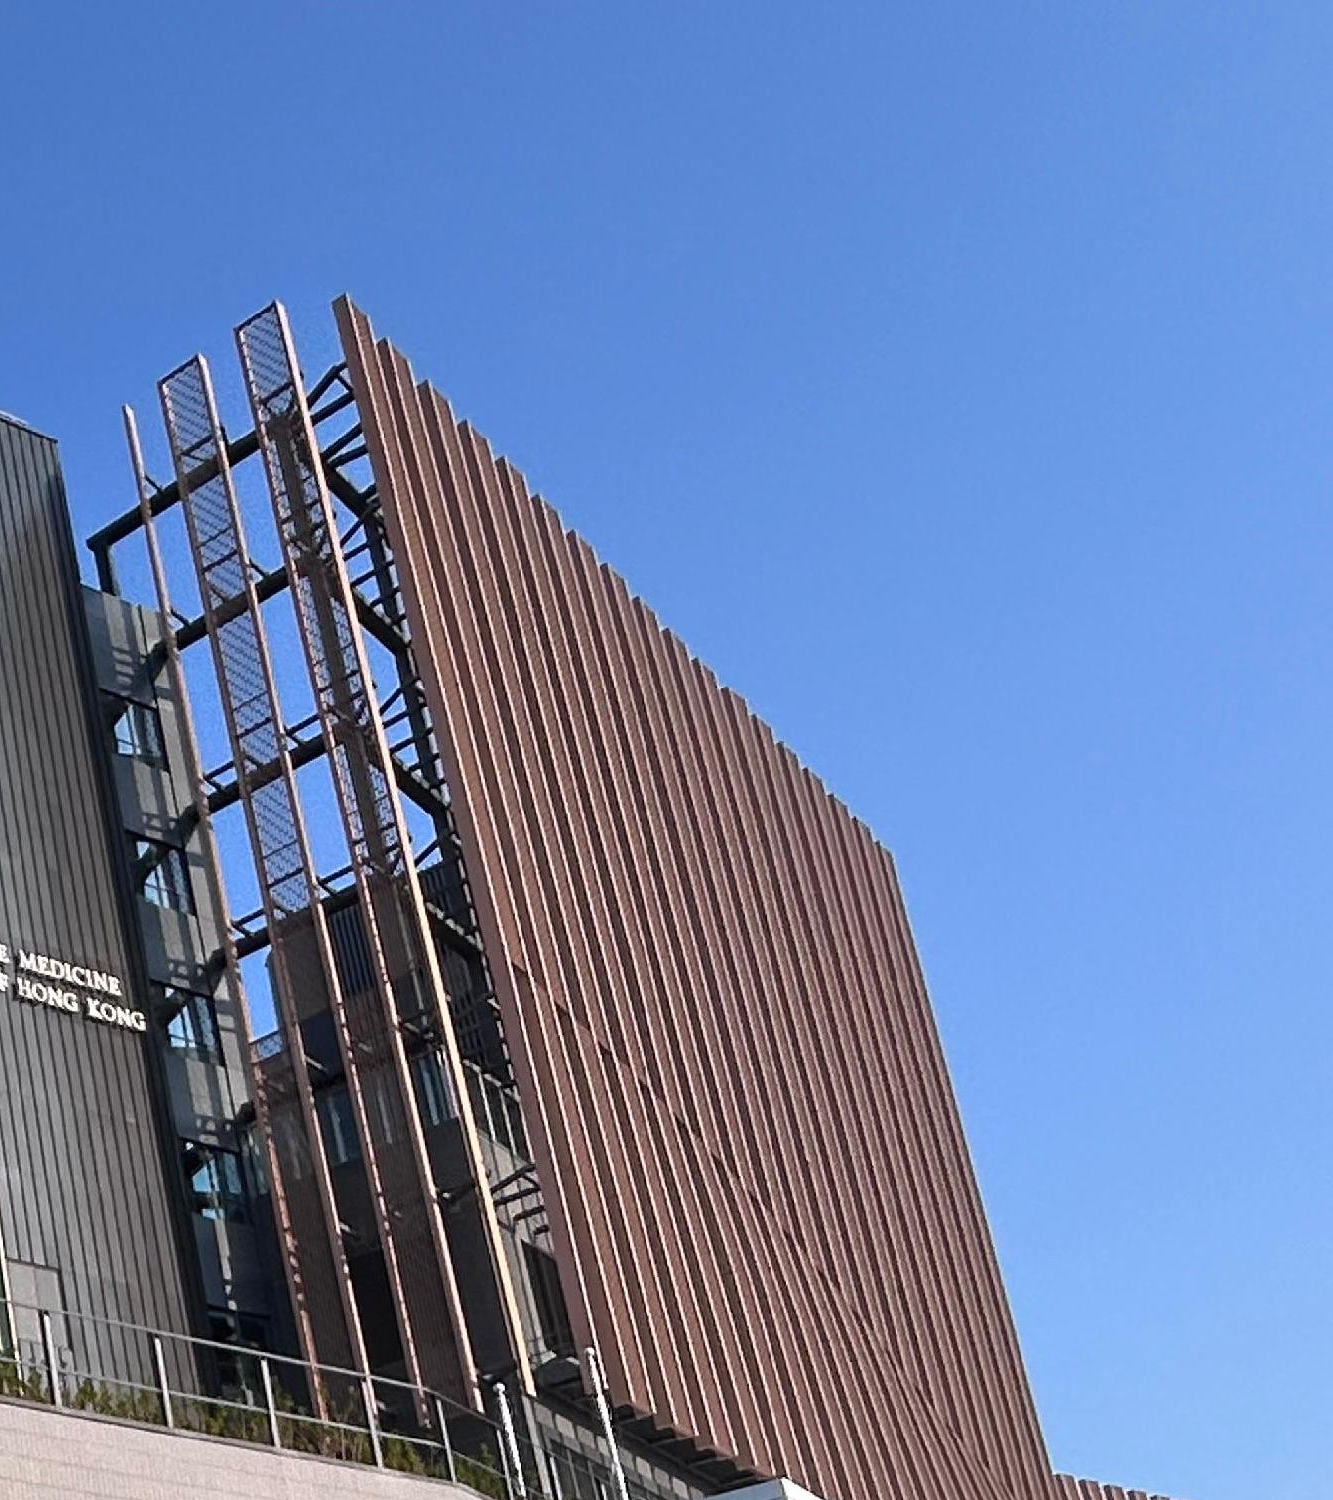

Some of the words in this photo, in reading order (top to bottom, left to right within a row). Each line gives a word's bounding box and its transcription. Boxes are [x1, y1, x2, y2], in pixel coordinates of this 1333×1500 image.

[18, 949, 122, 997] MEDICINE
[17, 977, 79, 1012] HONG
[86, 997, 147, 1032] KONG
